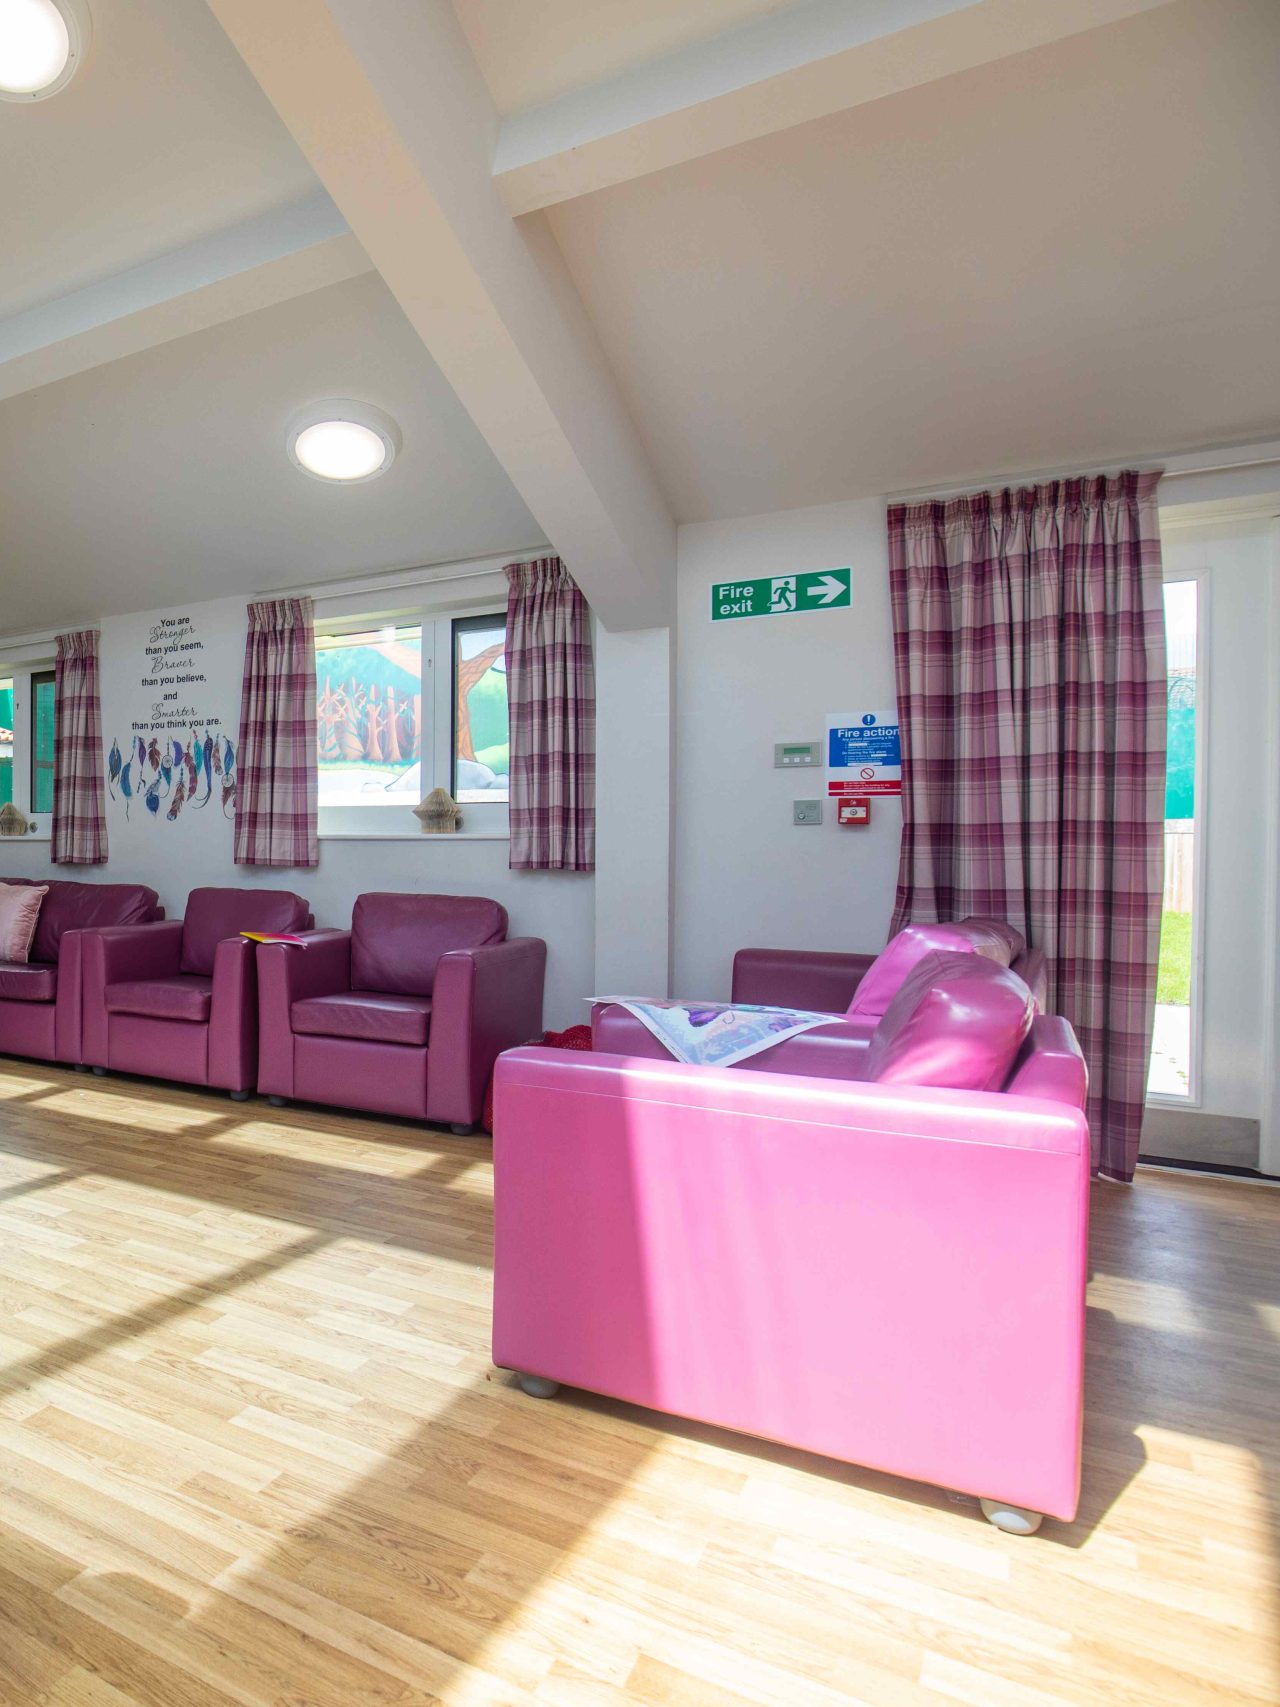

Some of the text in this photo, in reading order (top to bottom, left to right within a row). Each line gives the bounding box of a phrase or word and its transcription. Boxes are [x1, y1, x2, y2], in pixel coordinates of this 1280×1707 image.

[720, 586, 754, 600] Fire
[720, 600, 752, 614] exit
[160, 619, 176, 628] You
[150, 626, 196, 645] Stronger
[145, 642, 204, 655] than you seem,
[151, 656, 195, 674] Braver
[142, 674, 207, 686] than you believe,
[163, 692, 178, 700] and
[152, 703, 198, 720] Smarter
[150, 722, 165, 731] you
[167, 720, 187, 728] think
[189, 720, 204, 729] you
[838, 728, 900, 738] Fire action
